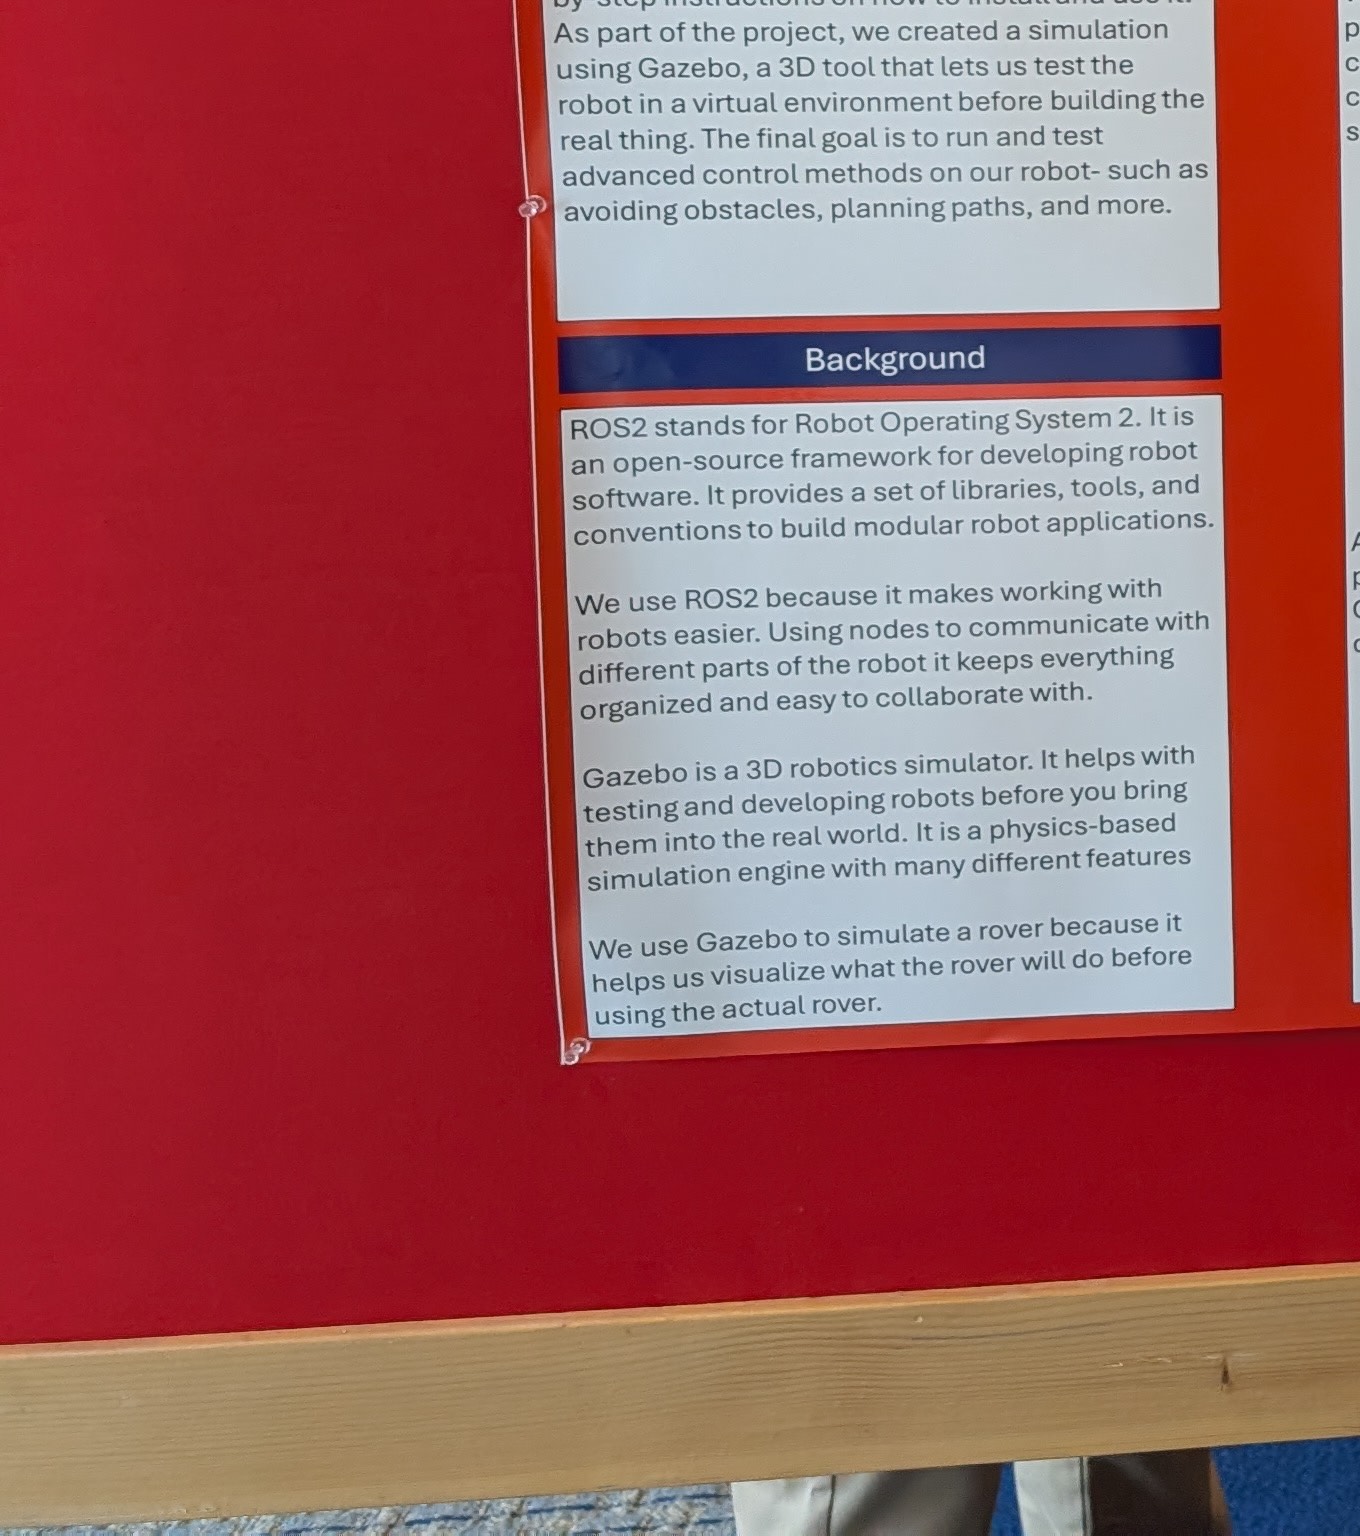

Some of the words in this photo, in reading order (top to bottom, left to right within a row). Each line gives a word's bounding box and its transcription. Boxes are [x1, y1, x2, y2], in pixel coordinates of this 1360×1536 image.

[563, 199, 679, 226] avoiding
[684, 198, 823, 223] obstacles,
[831, 196, 946, 224] planning
[951, 195, 1033, 223] paths,
[1040, 194, 1089, 216] and
[1097, 198, 1172, 215] more.
[807, 345, 984, 376] Background
[570, 416, 648, 441] ROS2
[654, 414, 746, 438] stands
[750, 413, 789, 435] for
[795, 412, 875, 434] Robot
[880, 410, 1010, 437] Operating
[1015, 408, 1112, 435] System
[1118, 407, 1142, 428] 2.
[1150, 406, 1167, 427] It
[1173, 405, 1194, 426] is
[582, 762, 688, 789] Gazebo
[695, 761, 717, 782] is
[723, 764, 739, 781] a
[746, 758, 783, 780] 3D
[790, 755, 898, 779] robotics
[904, 752, 1034, 775] simulator.
[1041, 749, 1059, 770] It
[1065, 747, 1136, 772] helps
[1140, 744, 1195, 766] with
